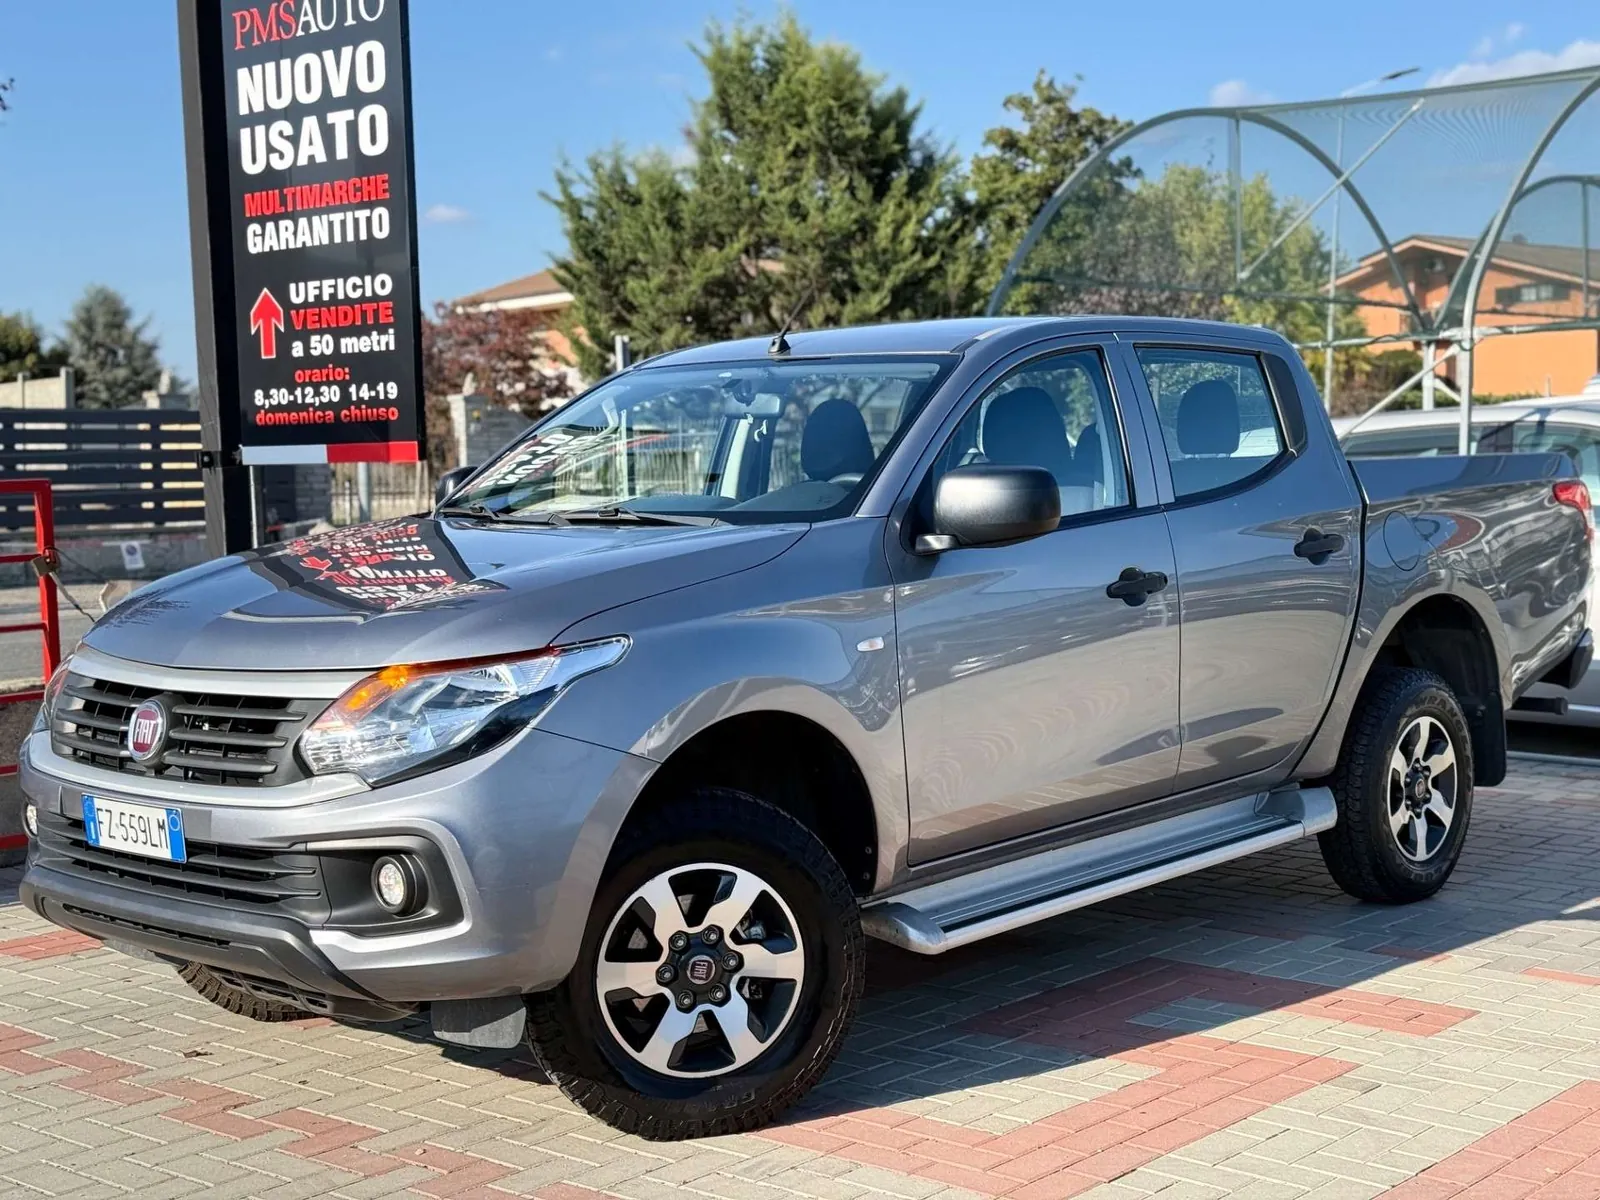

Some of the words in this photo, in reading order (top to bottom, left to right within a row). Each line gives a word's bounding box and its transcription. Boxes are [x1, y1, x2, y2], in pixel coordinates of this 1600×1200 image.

[237, 40, 386, 115] NUOVO
[240, 104, 389, 175] USATO
[244, 173, 390, 217] MULTIMARCHE
[247, 206, 390, 254] GARANTITO
[289, 273, 393, 304] UFFICIO
[290, 301, 394, 330] VENDITE
[291, 340, 304, 358] a
[310, 334, 334, 356] 50
[340, 328, 395, 354] metri
[294, 363, 350, 383] orario:
[254, 385, 340, 409] 8,30-12,30
[349, 381, 398, 401] 14-19
[255, 407, 334, 426] domenica
[340, 404, 399, 422] chiuso
[133, 718, 157, 744] FIAT
[693, 961, 708, 979] FIAT
